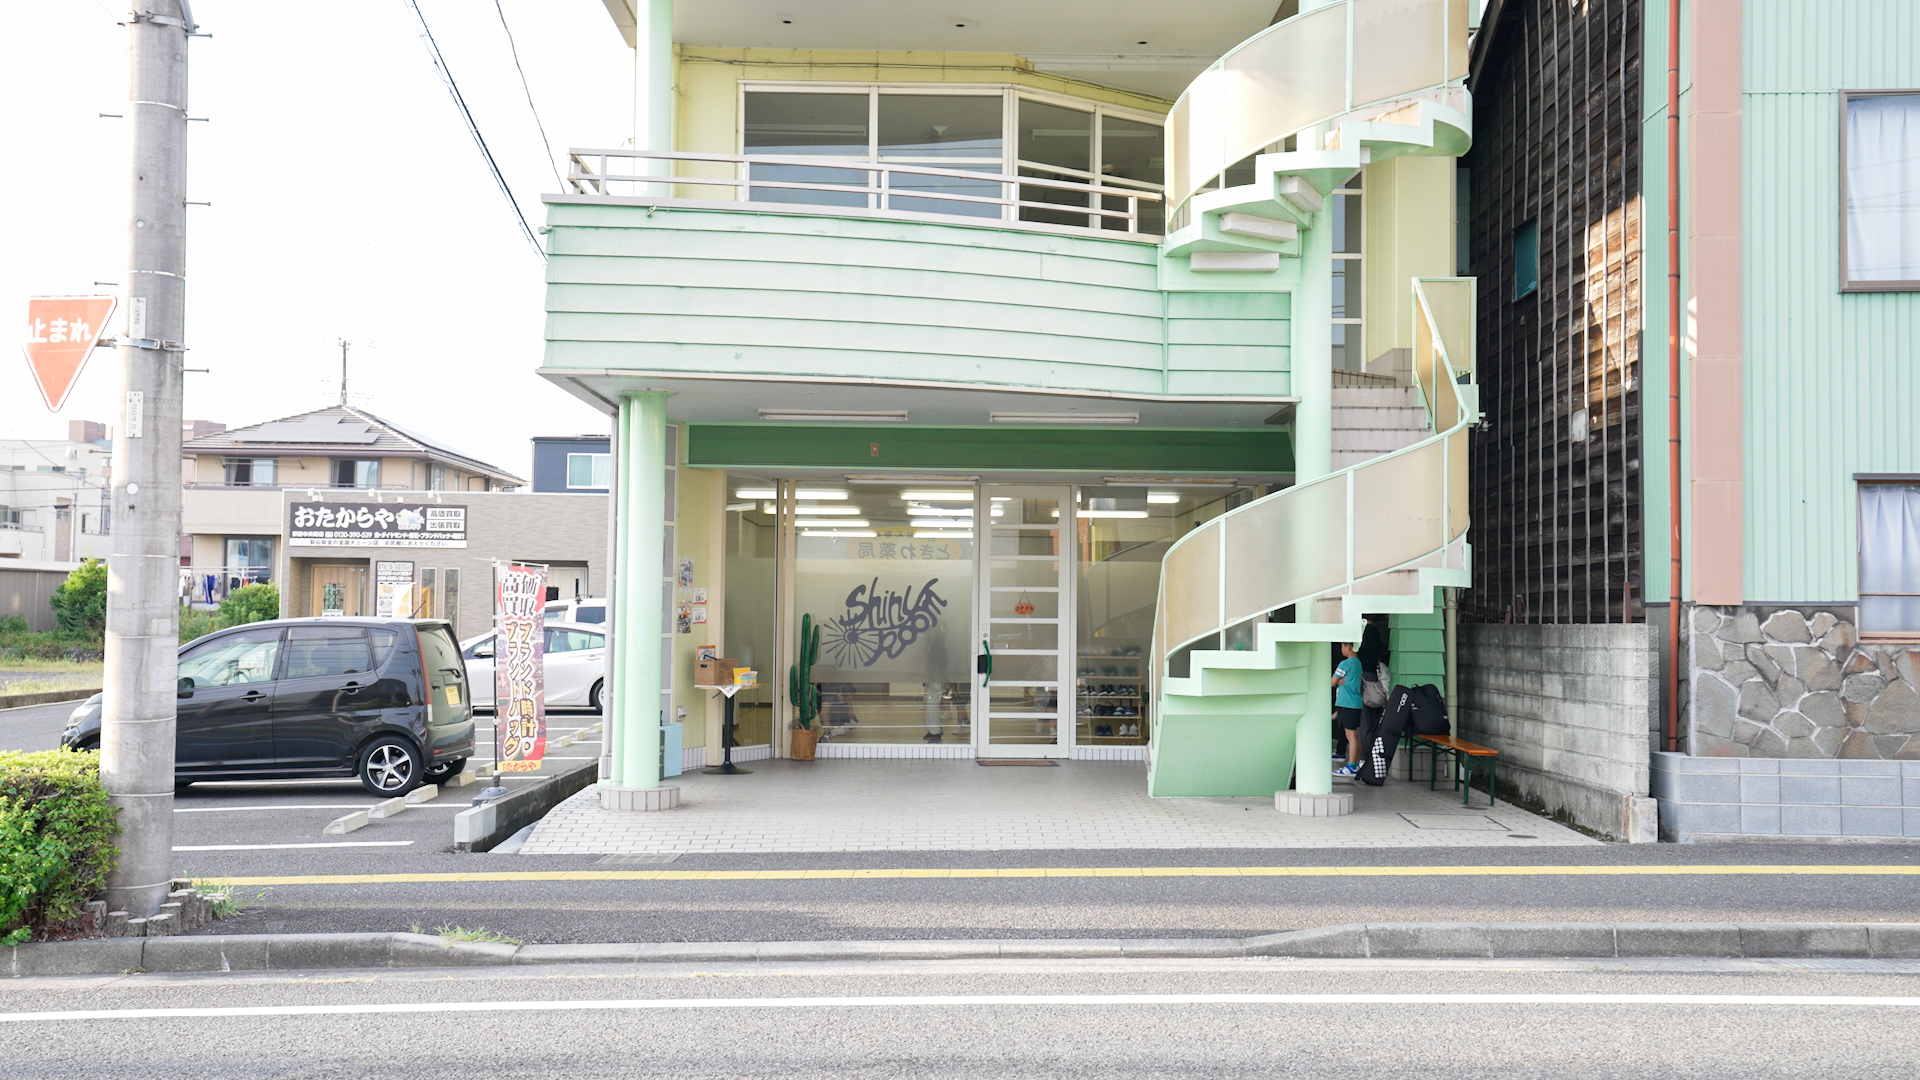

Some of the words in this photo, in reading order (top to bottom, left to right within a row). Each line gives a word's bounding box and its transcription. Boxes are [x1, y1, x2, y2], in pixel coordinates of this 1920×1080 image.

[26, 317, 92, 343] 止まれ
[294, 505, 395, 529] おたからや
[430, 509, 462, 518] 高価買取
[333, 531, 373, 539] 0120-390-539
[429, 521, 461, 530] 出張買取
[502, 573, 539, 595] 高価
[502, 596, 535, 616] 買取
